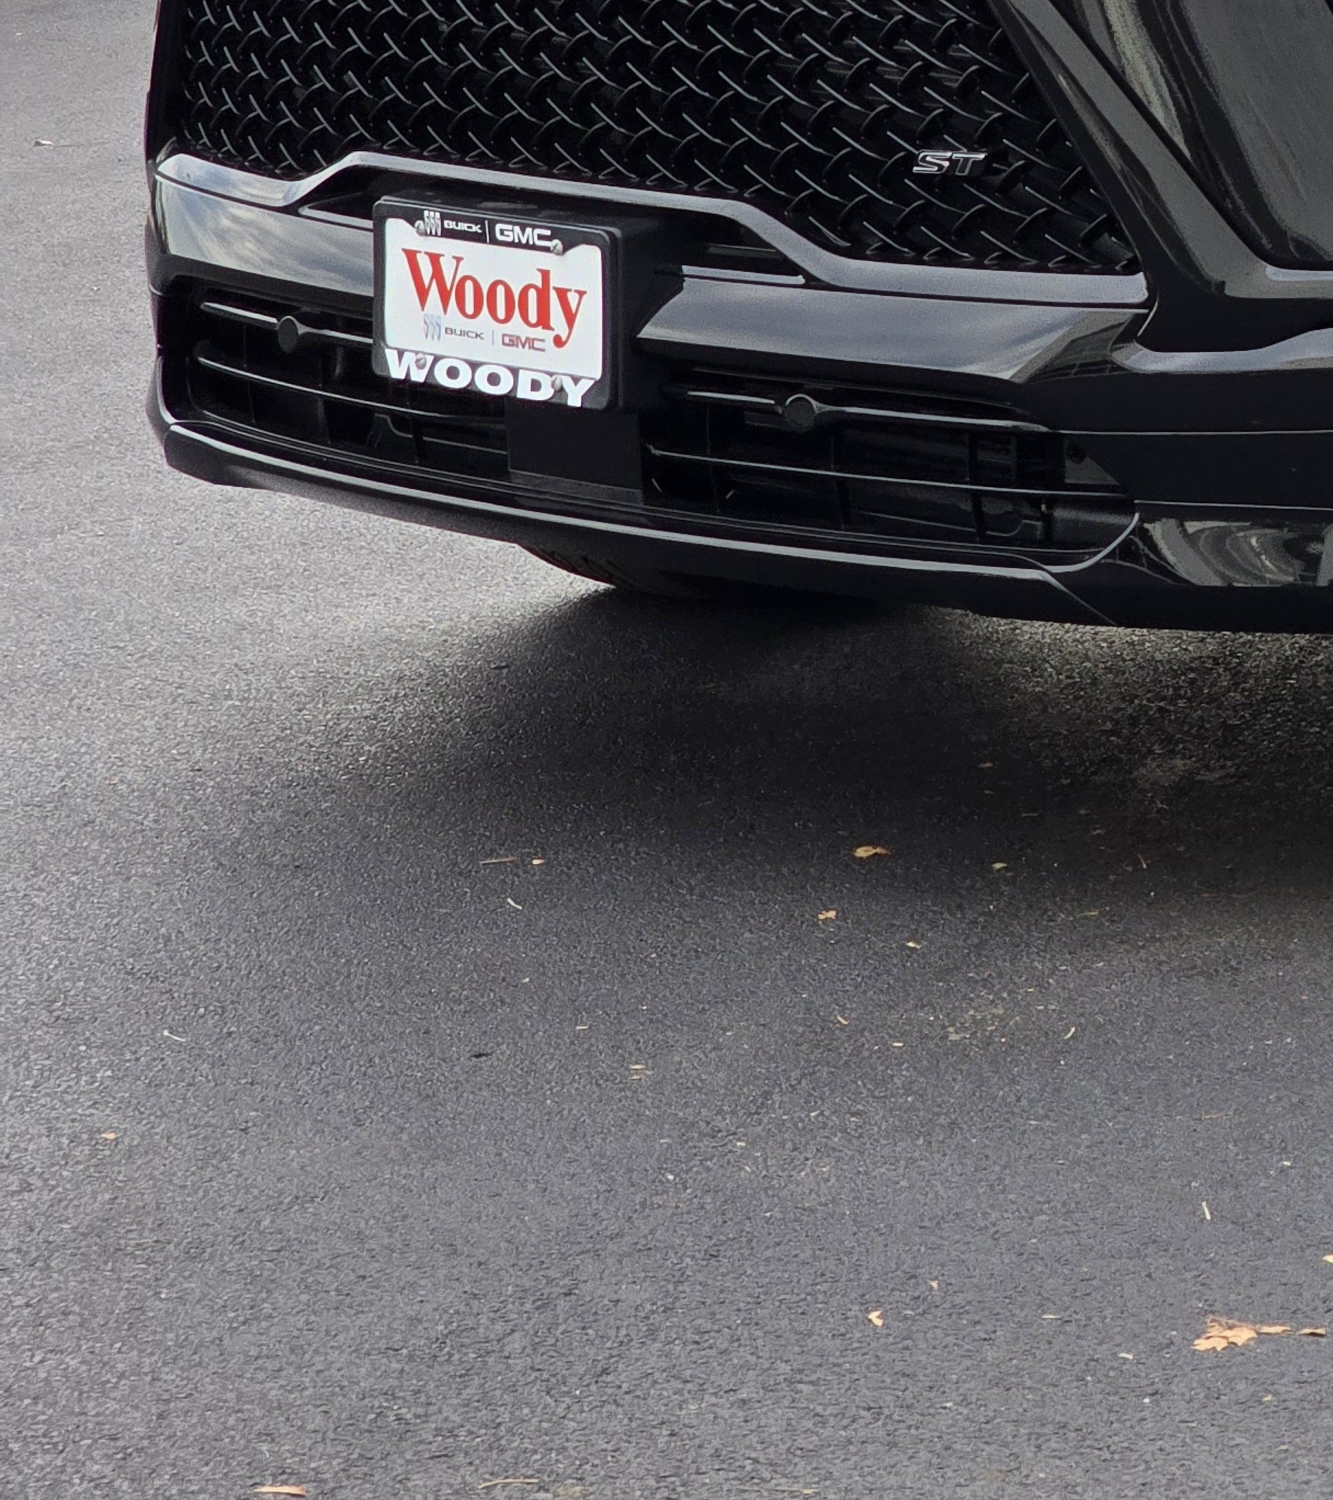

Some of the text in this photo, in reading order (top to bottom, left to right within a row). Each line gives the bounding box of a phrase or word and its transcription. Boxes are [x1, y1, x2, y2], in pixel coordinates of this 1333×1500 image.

[912, 149, 988, 176] ST
[443, 219, 553, 247] BUICK GMC
[401, 247, 588, 349] Woody
[444, 326, 546, 352] BUICK GMC
[384, 348, 596, 408] WOODY
